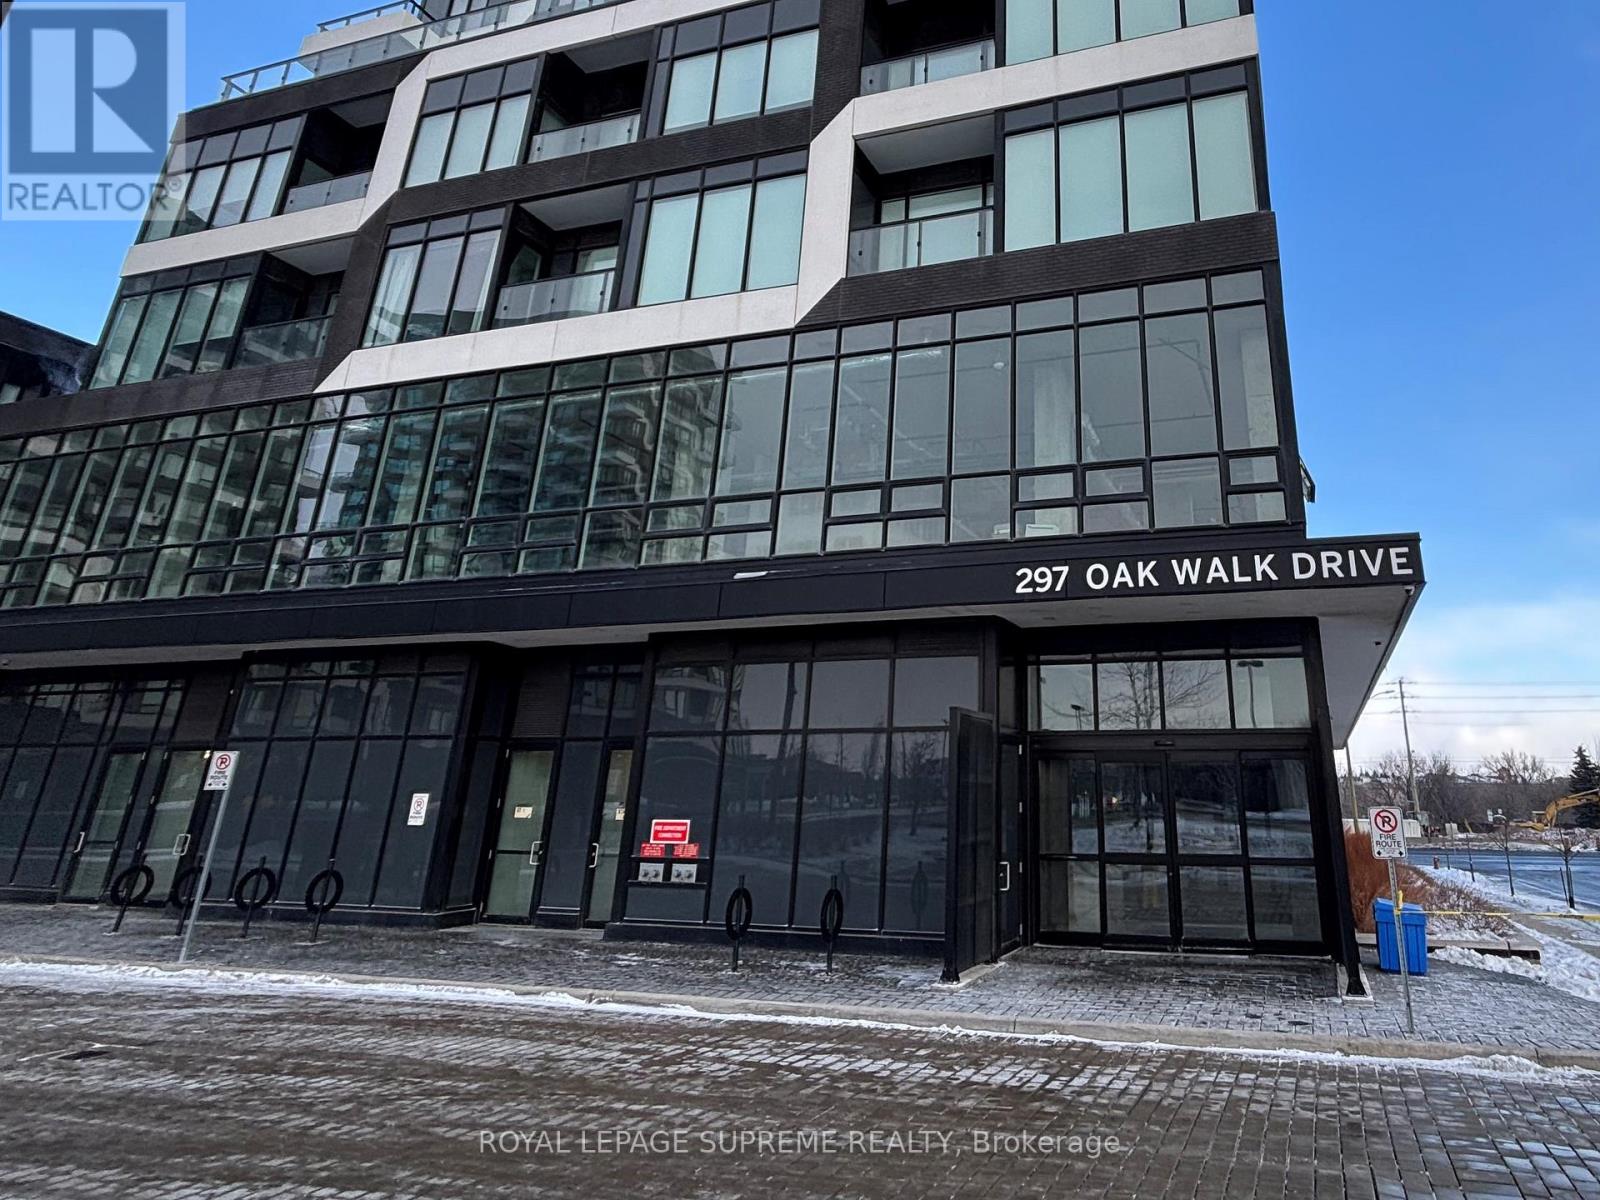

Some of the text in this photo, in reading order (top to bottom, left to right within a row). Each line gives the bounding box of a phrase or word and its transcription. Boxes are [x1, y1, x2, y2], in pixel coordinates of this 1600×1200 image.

[1015, 546, 1413, 594] 297 OAK WALK DRIVE
[1379, 833, 1397, 841] FIRE
[1375, 840, 1403, 848] ROUTE
